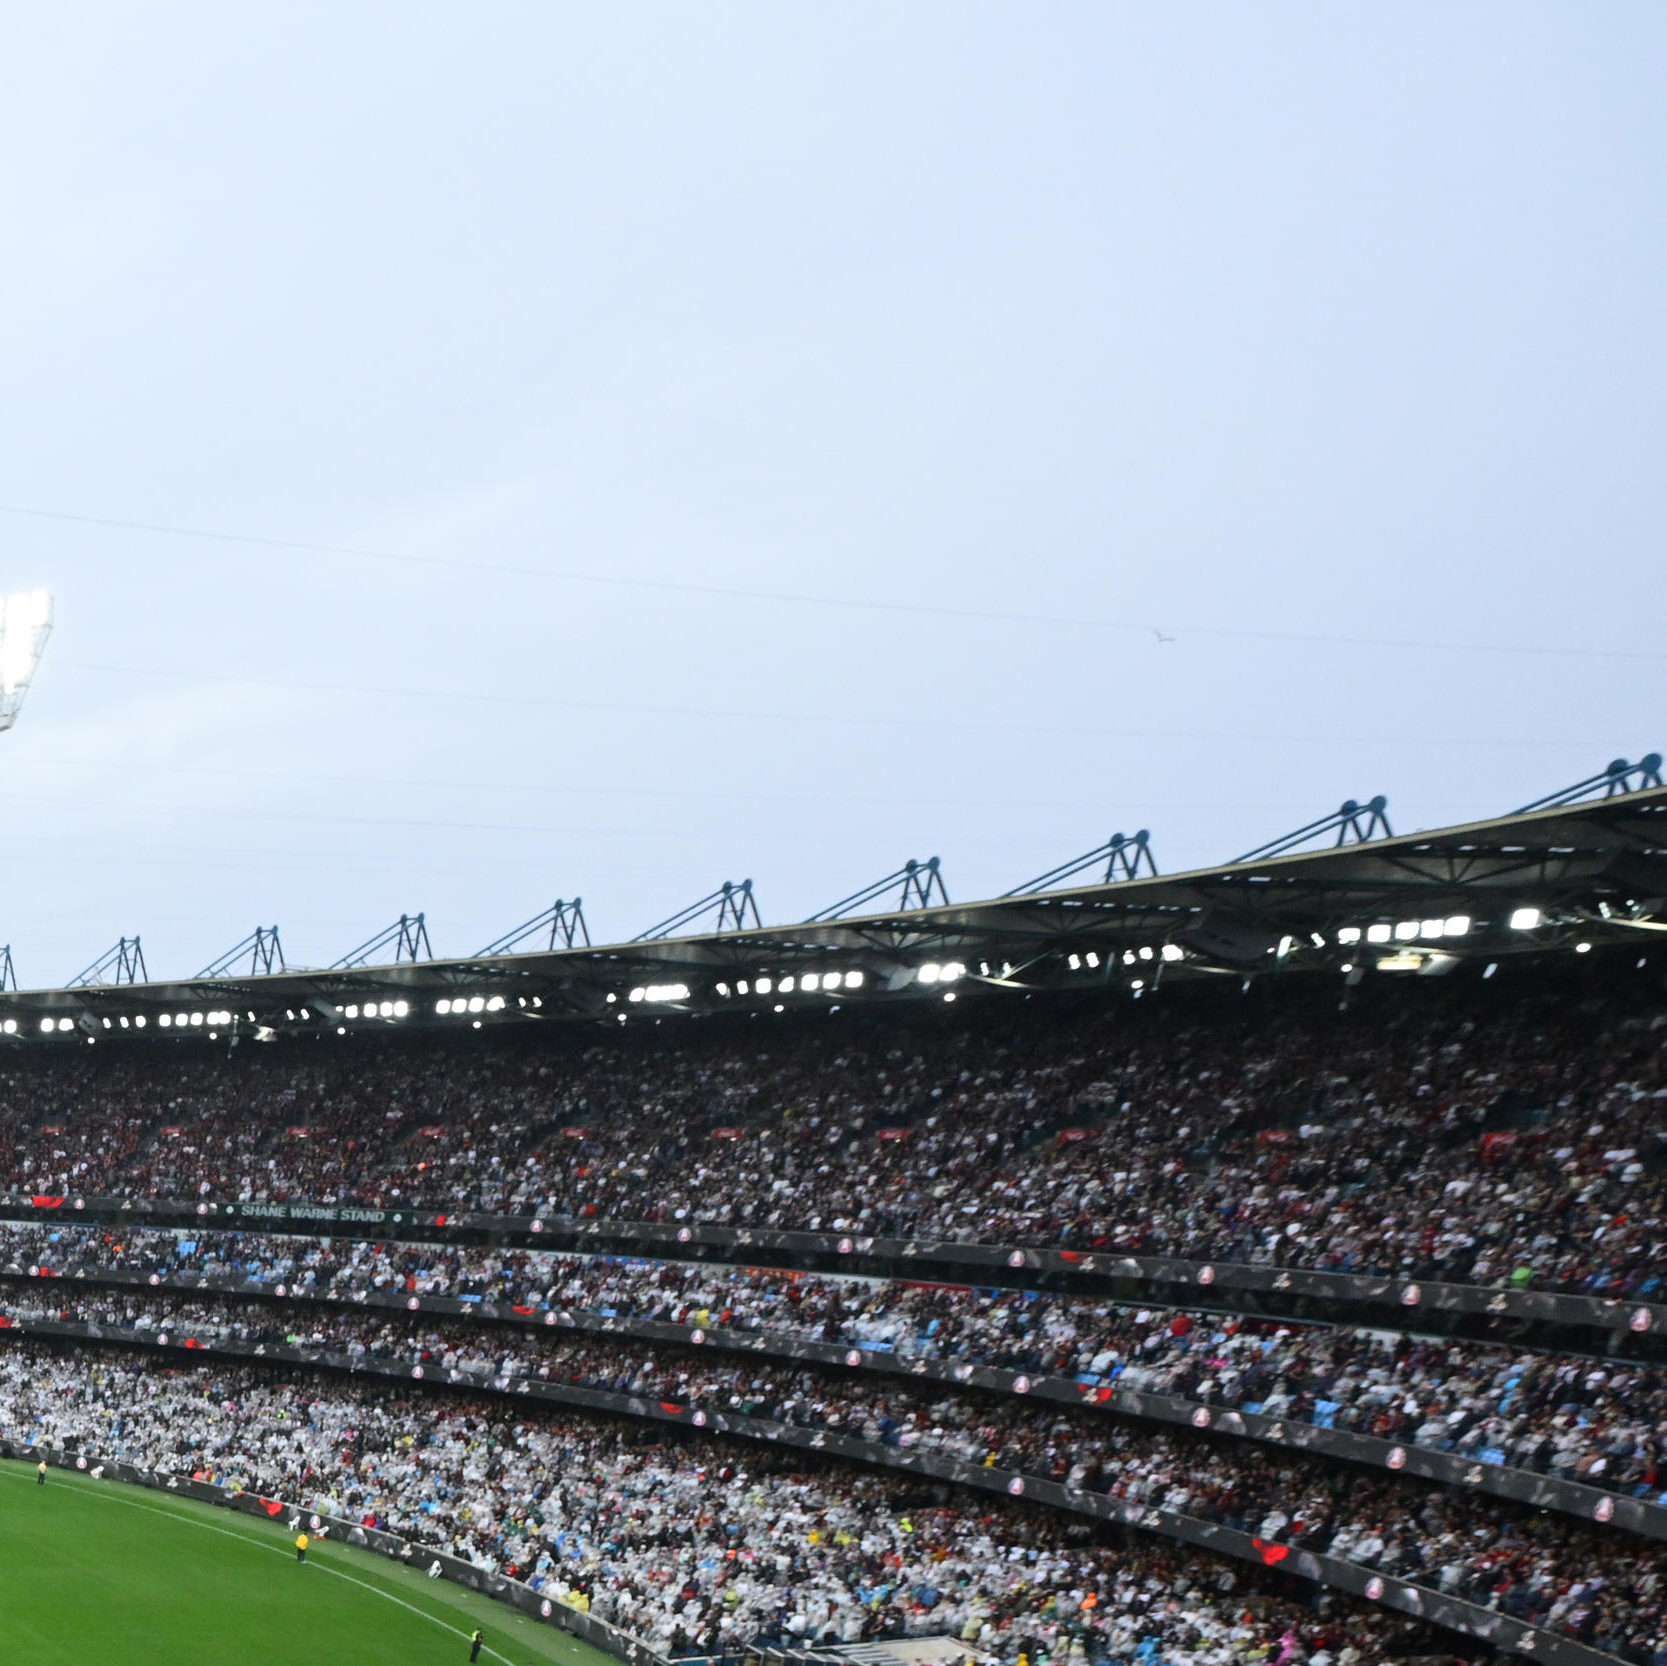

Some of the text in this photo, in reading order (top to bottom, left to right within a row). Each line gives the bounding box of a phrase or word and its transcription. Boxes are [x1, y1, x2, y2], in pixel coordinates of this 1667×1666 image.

[241, 1204, 385, 1222] SHANE WARNE STAND
